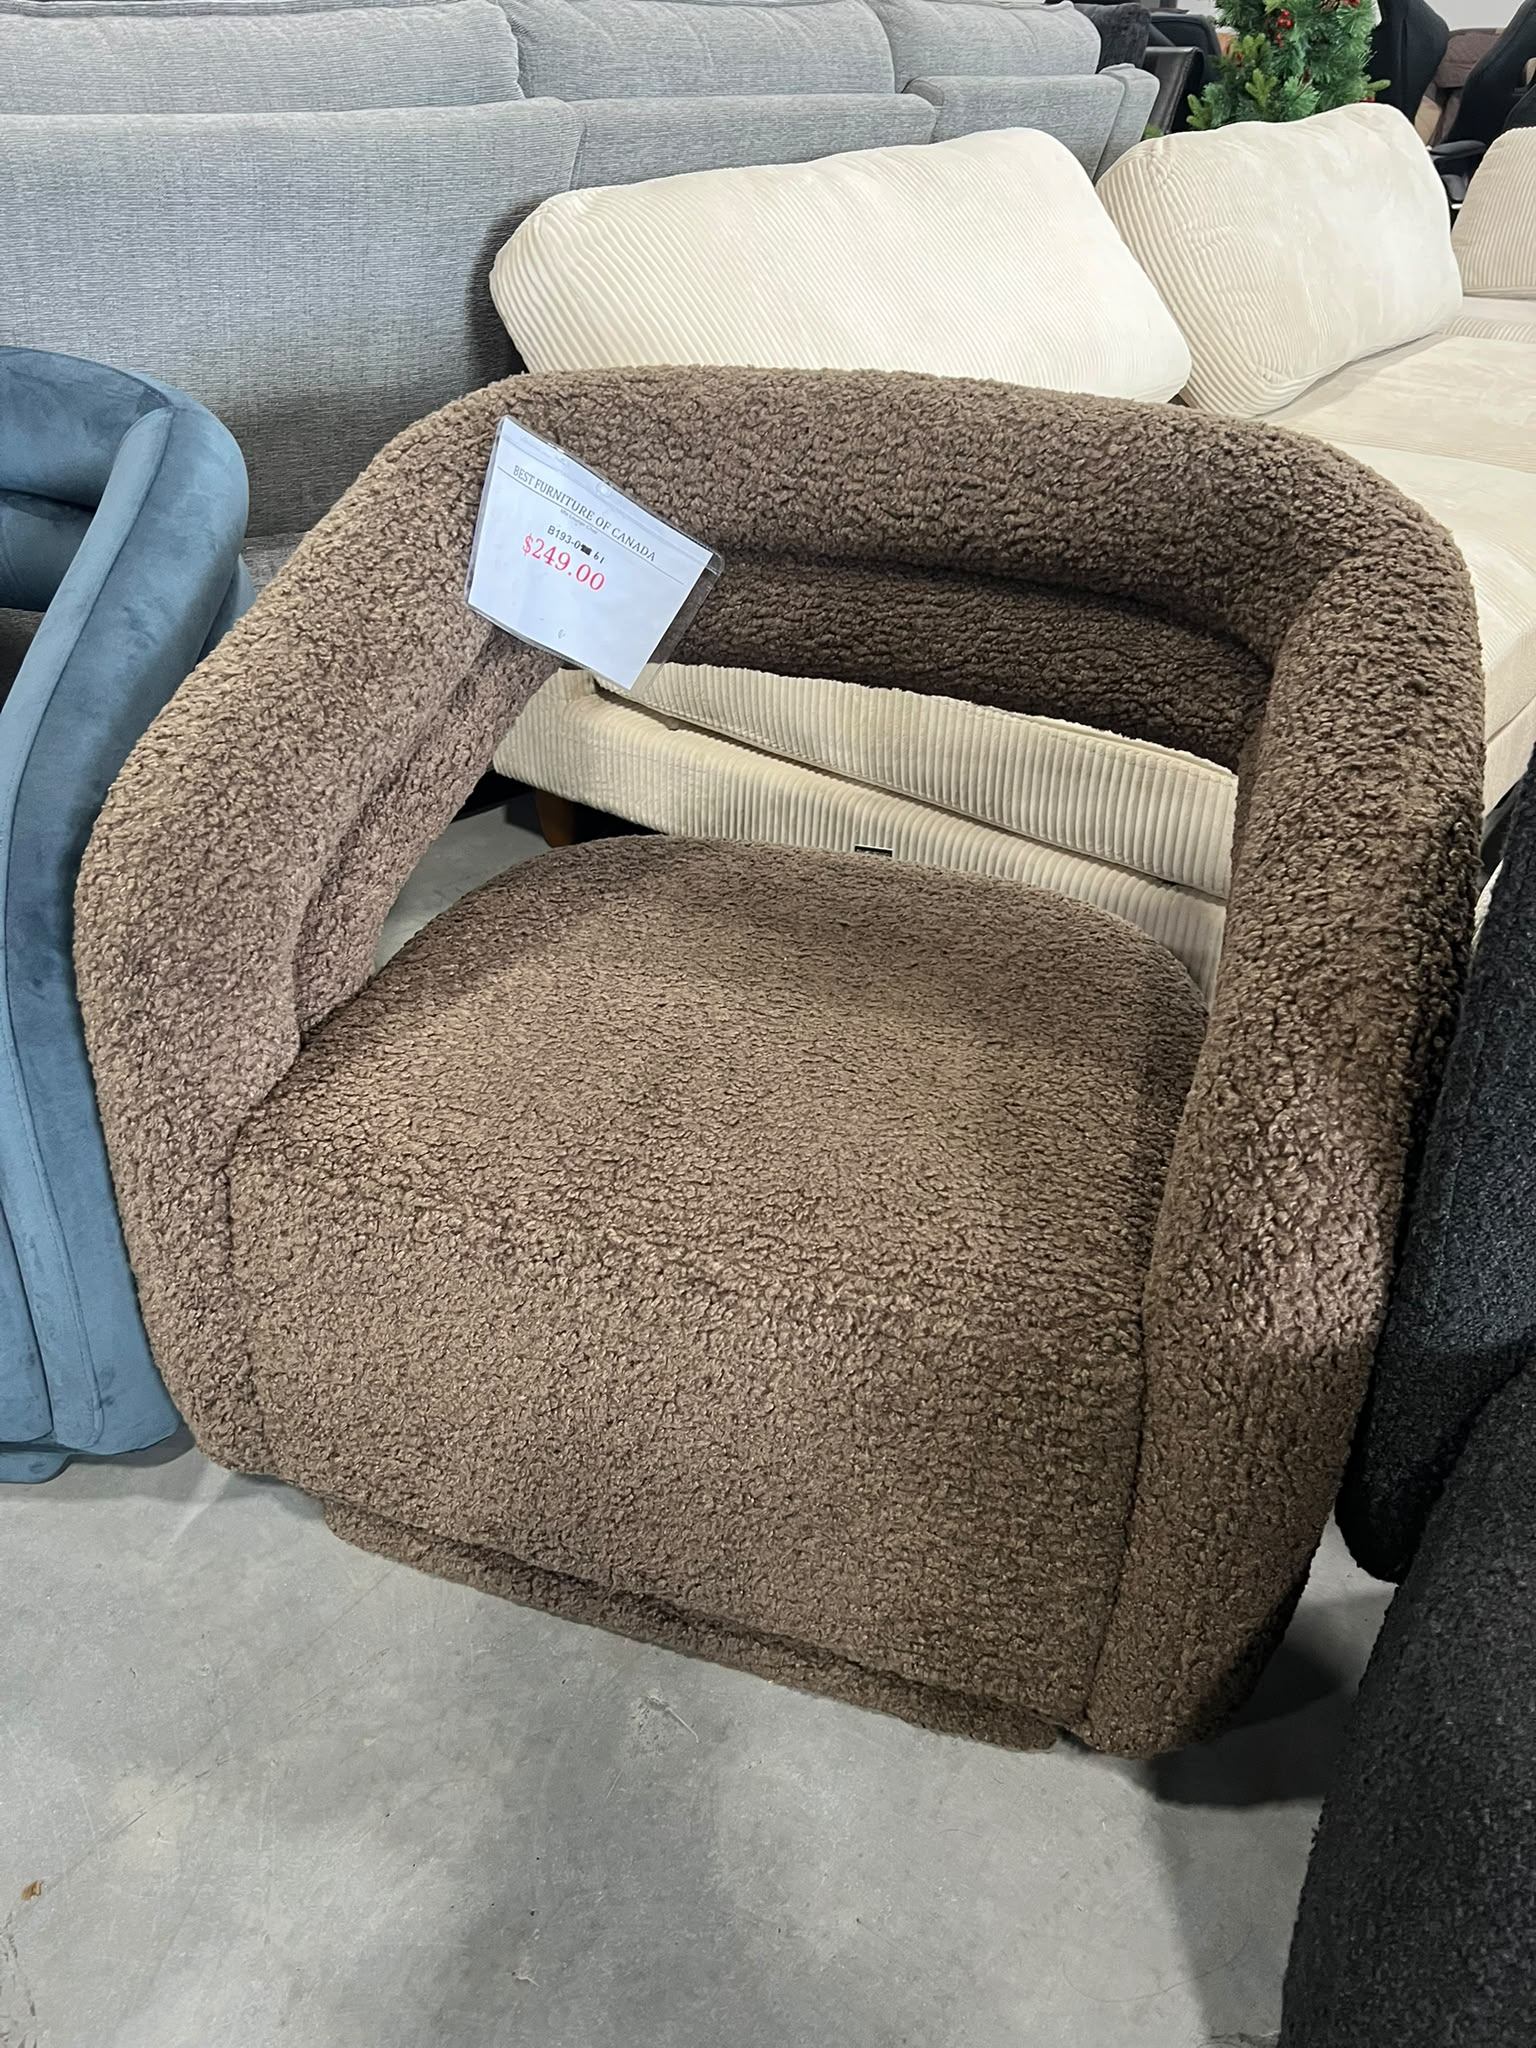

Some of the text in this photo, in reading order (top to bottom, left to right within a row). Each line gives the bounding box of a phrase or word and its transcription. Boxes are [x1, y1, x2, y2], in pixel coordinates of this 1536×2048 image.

[513, 465, 534, 485] BEST
[535, 478, 595, 521] FURNITURE
[595, 516, 612, 533] OF
[612, 528, 656, 561] CANADA
[522, 534, 605, 591] $249.00
